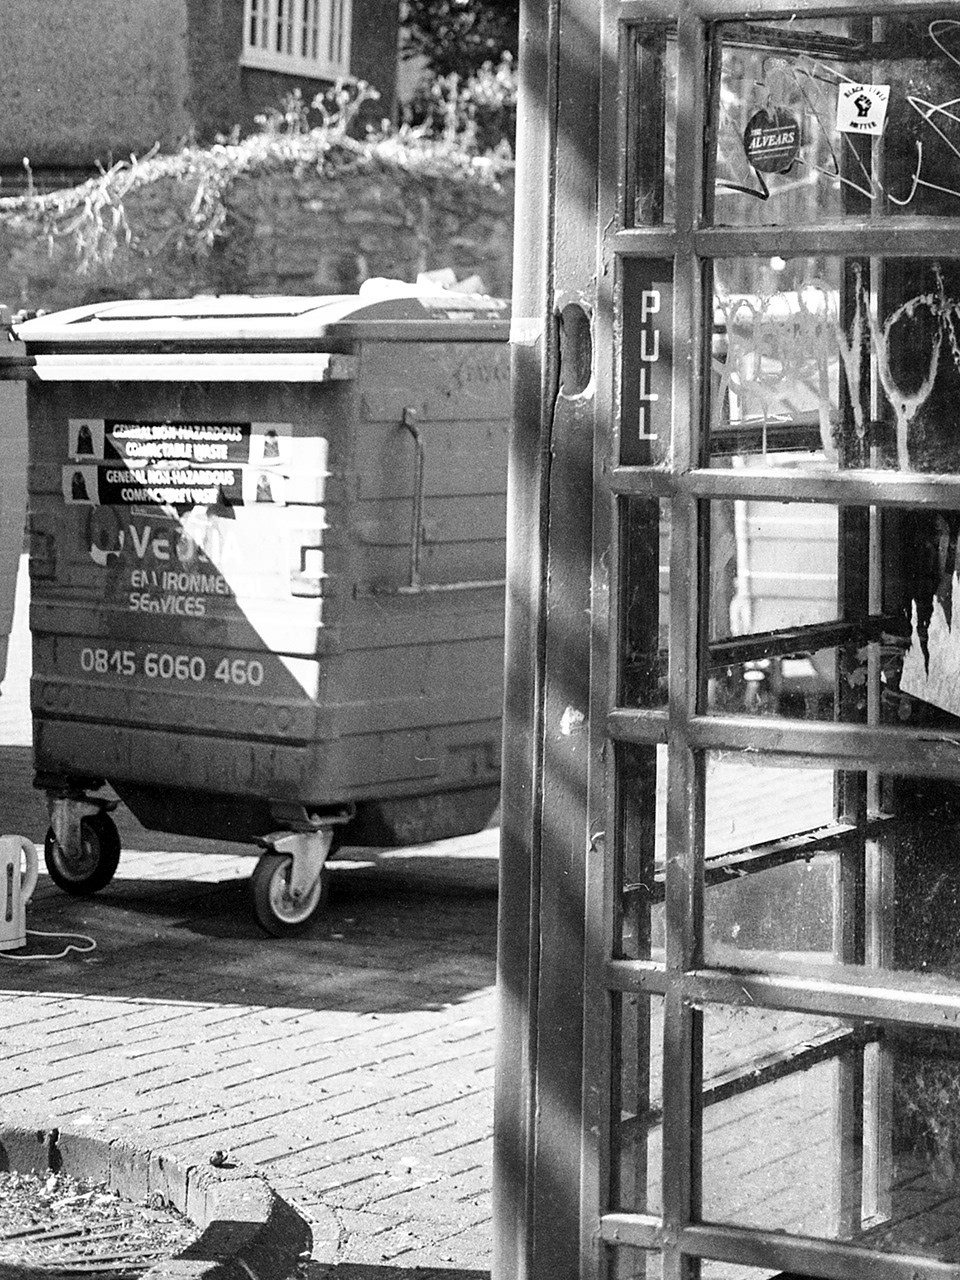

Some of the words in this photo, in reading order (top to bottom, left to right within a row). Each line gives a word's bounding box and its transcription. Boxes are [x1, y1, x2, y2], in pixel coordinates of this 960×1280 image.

[748, 131, 796, 149] ALVEARS
[639, 290, 660, 440] PULL
[112, 424, 150, 440] GENERAL
[105, 469, 147, 484] GENERAL
[147, 469, 235, 486] NON-HAZARDOUS
[80, 647, 136, 676] 0845
[144, 653, 206, 682] 6060
[214, 658, 265, 687] 460
